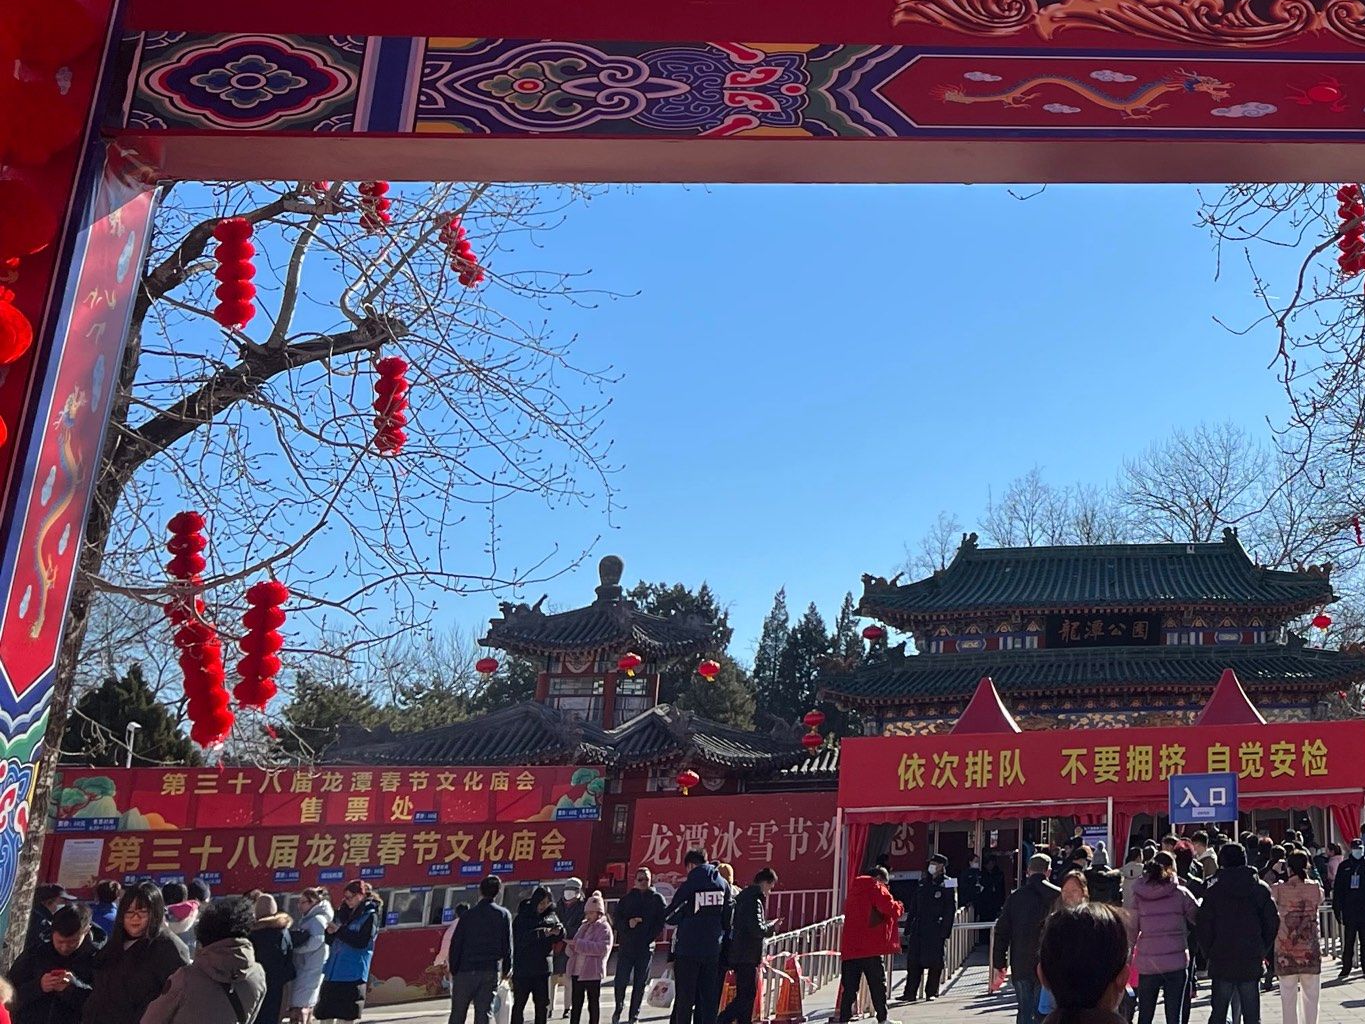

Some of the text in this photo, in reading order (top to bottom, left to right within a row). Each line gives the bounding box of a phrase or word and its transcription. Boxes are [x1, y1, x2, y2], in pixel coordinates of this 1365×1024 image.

[898, 739, 1330, 791] 依次排队 不要拥挤 自觉安检
[160, 770, 536, 796] 第三十八届龙潭春节文化庙会
[300, 795, 414, 824] 售票处
[1179, 786, 1227, 808] 入口
[104, 828, 567, 874] 第三十八届龙潭春节文化庙会
[693, 890, 725, 914] NETS
